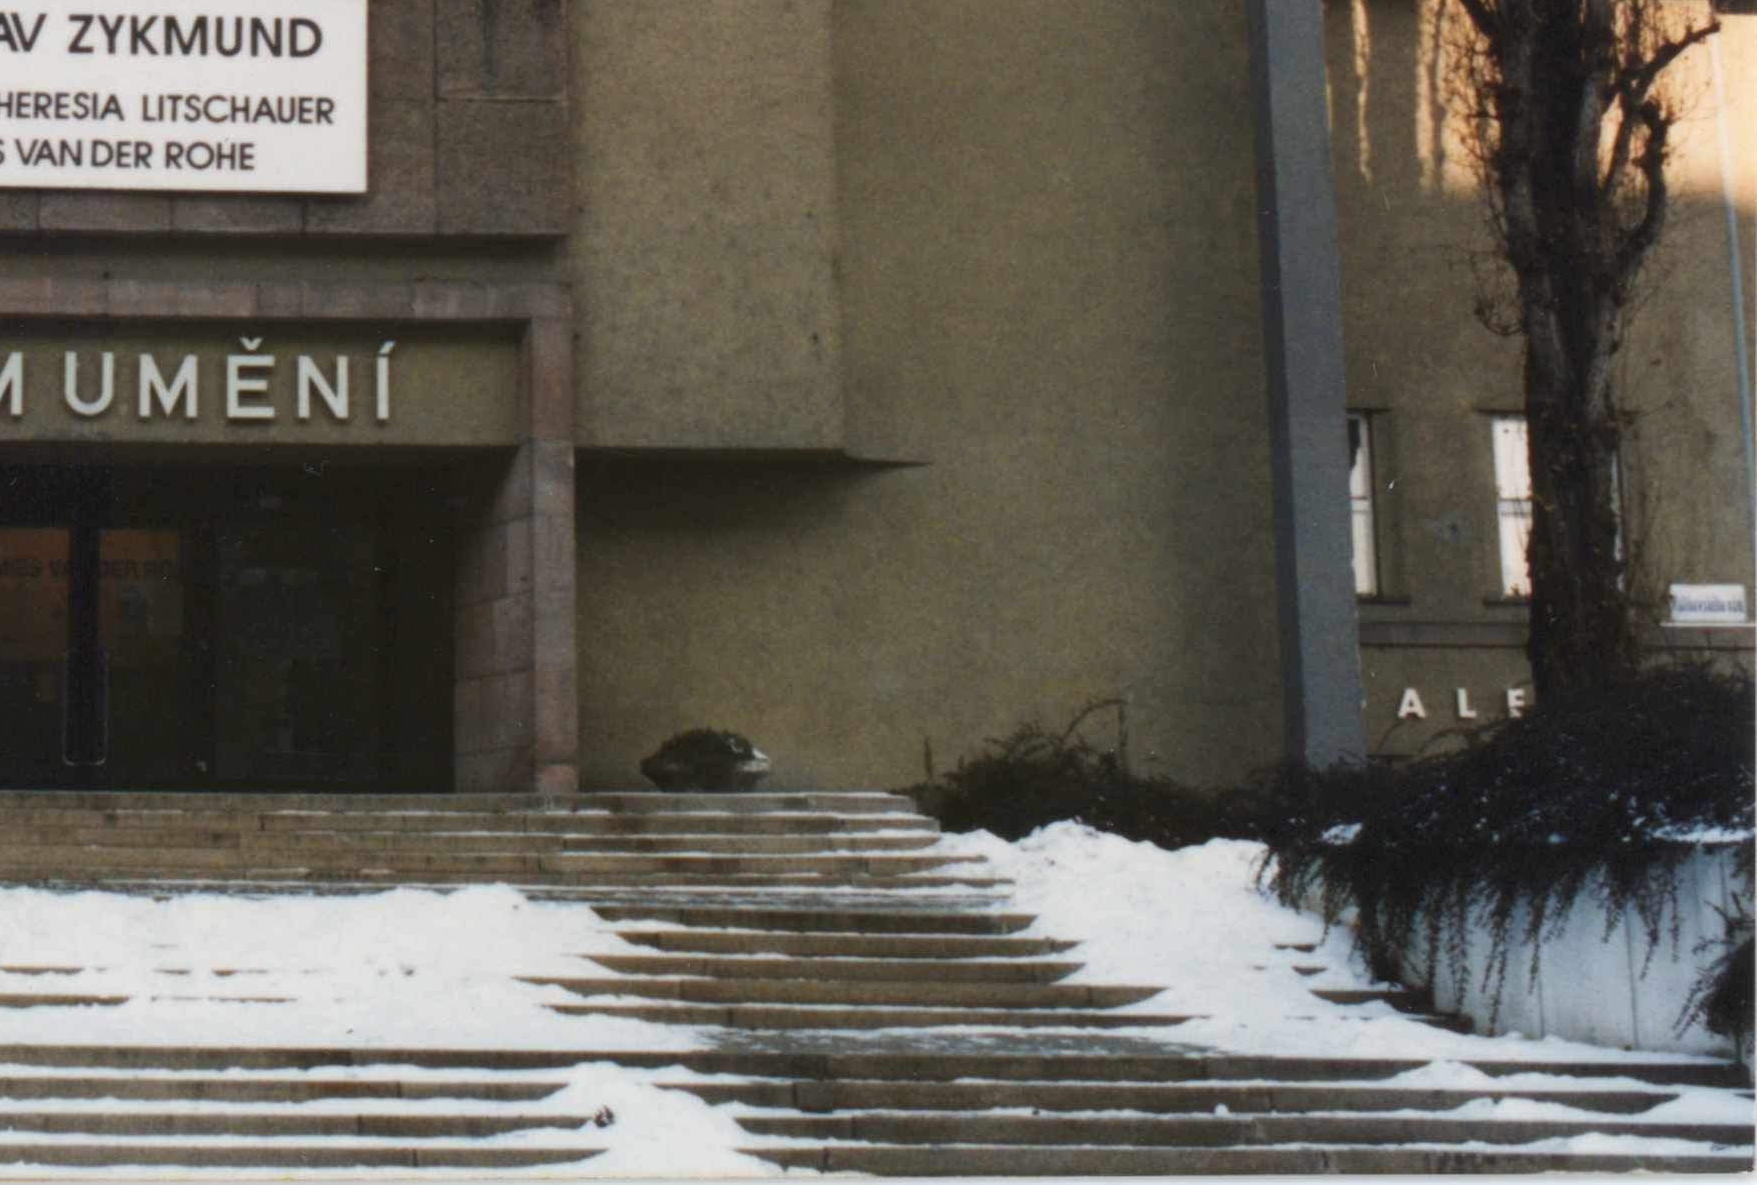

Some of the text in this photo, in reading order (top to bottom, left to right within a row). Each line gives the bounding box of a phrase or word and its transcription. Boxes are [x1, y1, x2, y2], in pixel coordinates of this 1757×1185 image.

[67, 13, 323, 58] ZYKMUND
[142, 94, 335, 125] LITSCHAUER
[14, 138, 83, 167] VAN
[90, 139, 153, 169] DER
[164, 141, 255, 171] ROHE
[64, 337, 395, 419] UMĚNÍ
